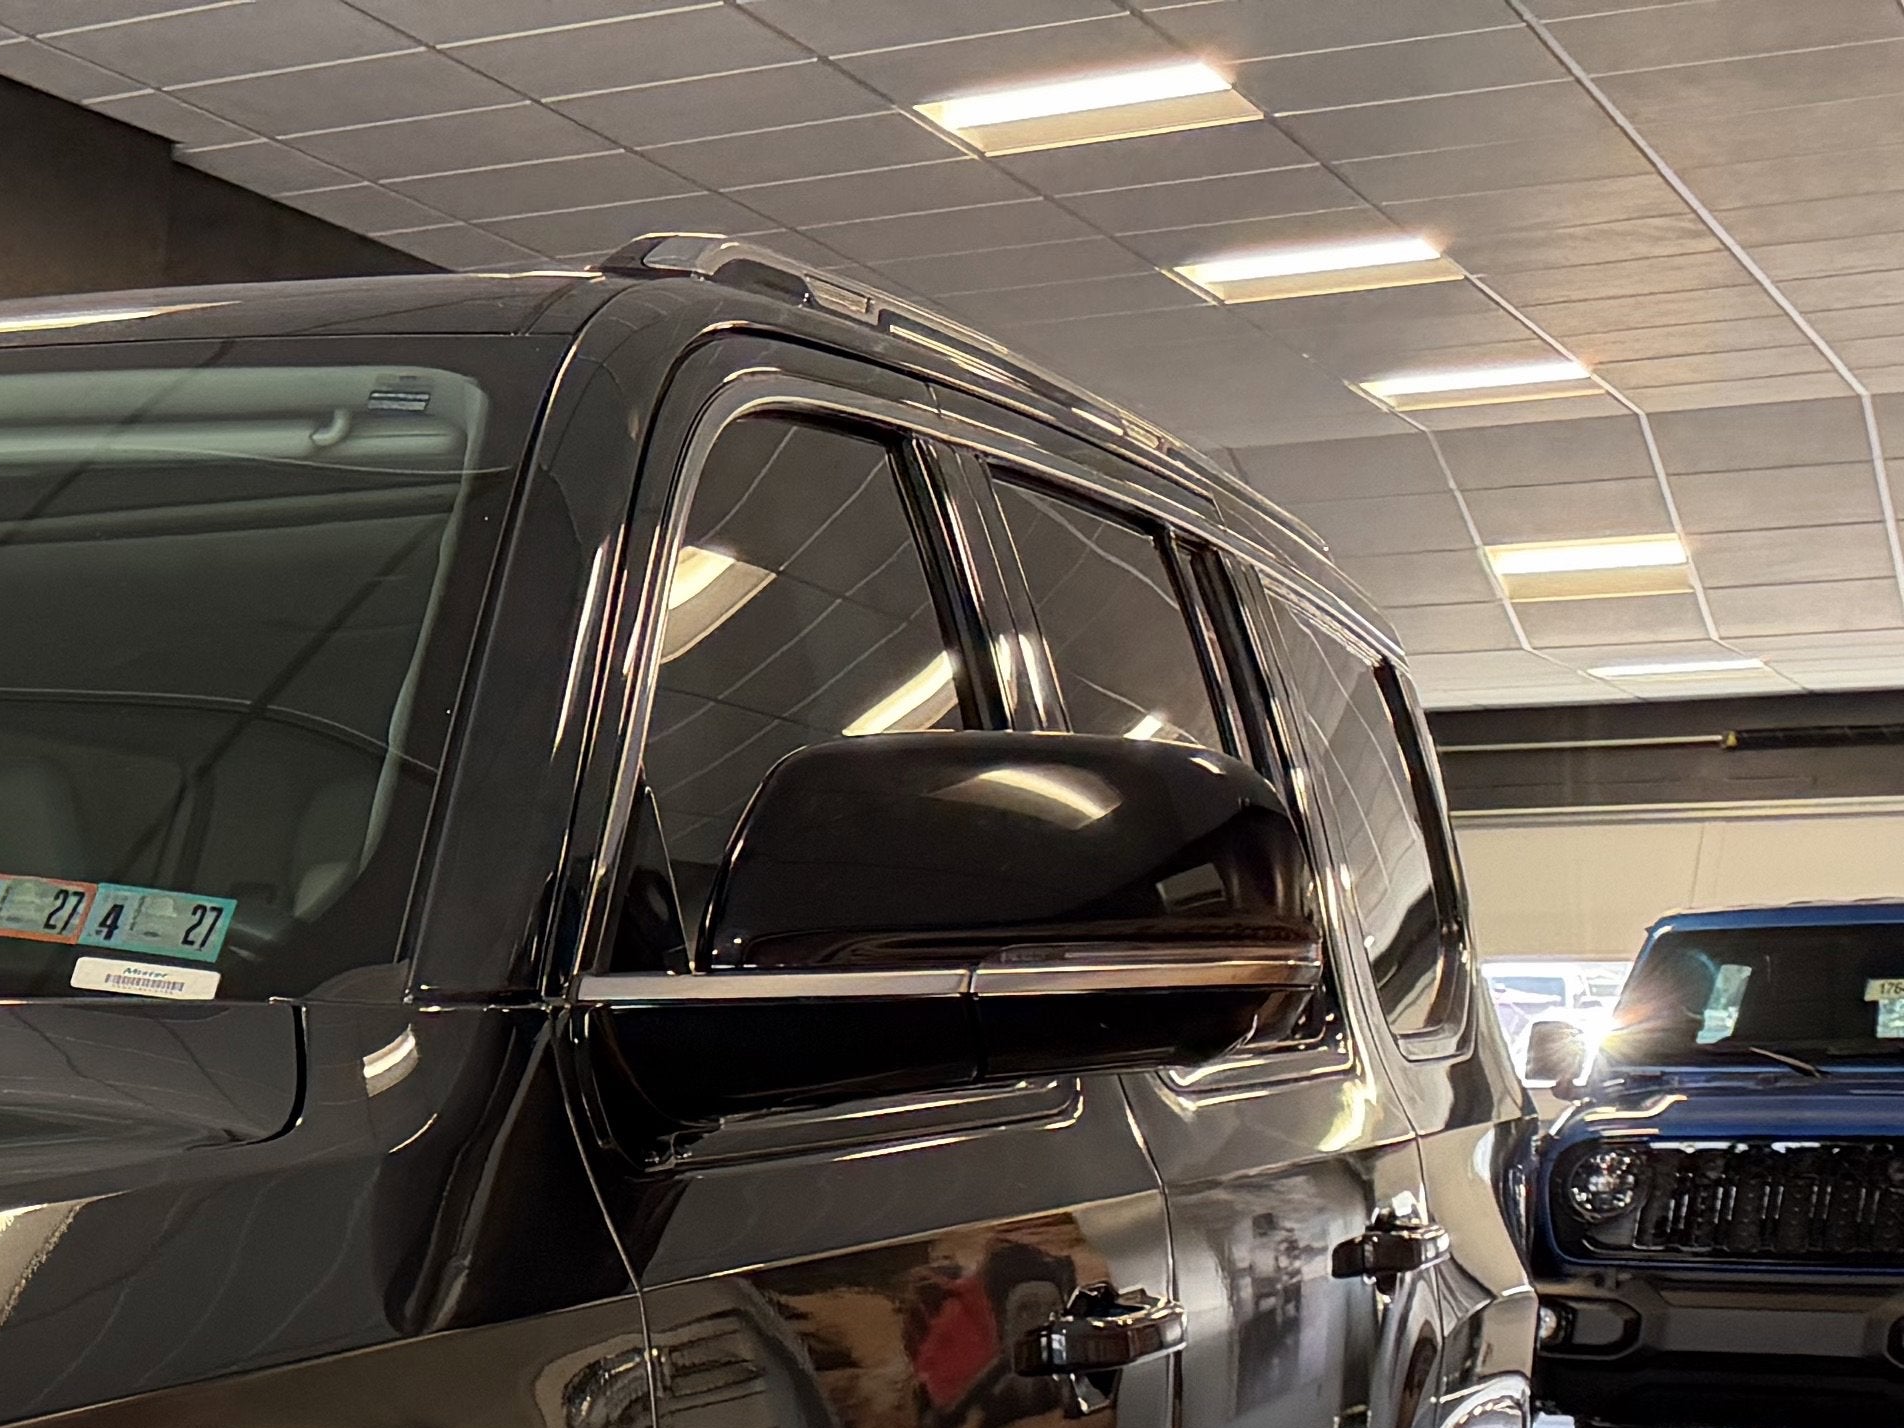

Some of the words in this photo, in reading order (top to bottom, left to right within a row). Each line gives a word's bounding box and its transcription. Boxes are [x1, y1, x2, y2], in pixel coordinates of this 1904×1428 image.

[43, 888, 86, 935] 27
[96, 903, 125, 941] 4
[180, 904, 224, 952] 27
